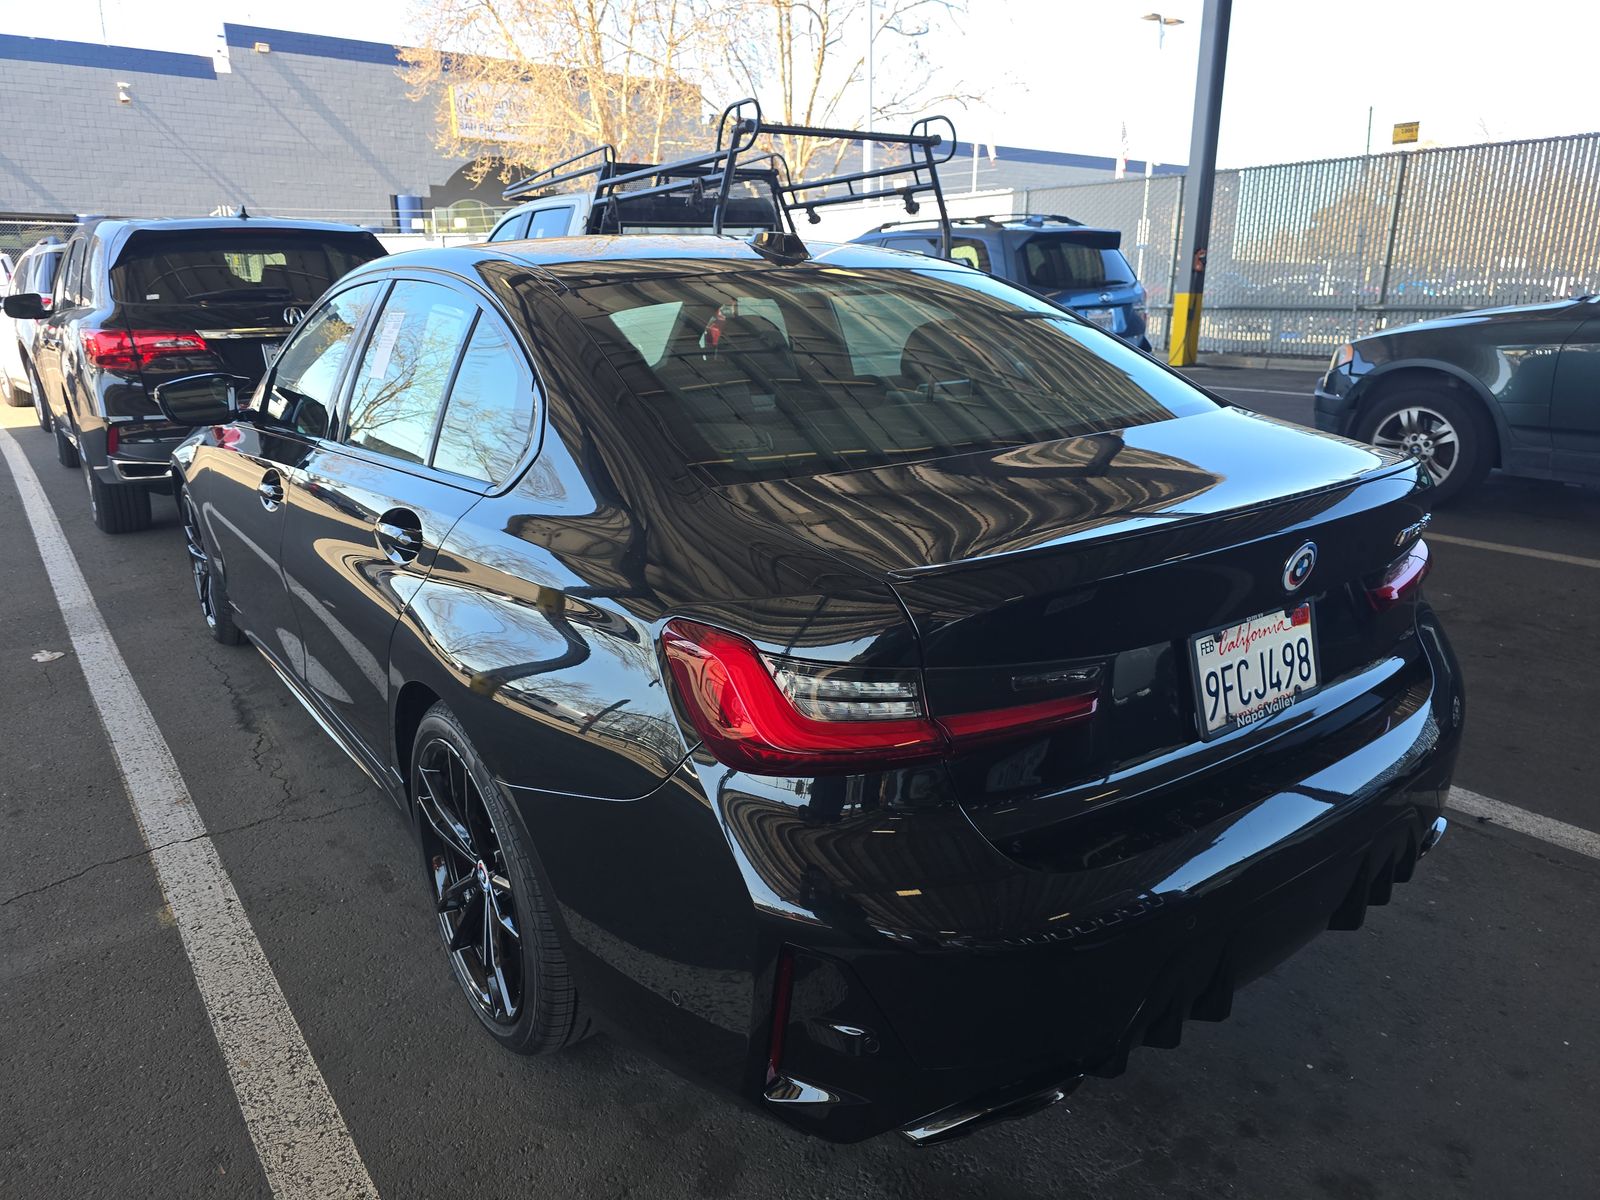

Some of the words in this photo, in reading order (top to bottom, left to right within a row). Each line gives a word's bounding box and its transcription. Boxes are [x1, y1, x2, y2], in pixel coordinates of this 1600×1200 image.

[1200, 639, 1215, 656] FEB
[1218, 618, 1292, 656] California
[1205, 637, 1312, 722] 9FCJ498
[1236, 709, 1265, 728] Napa
[1265, 695, 1296, 714] Valley
